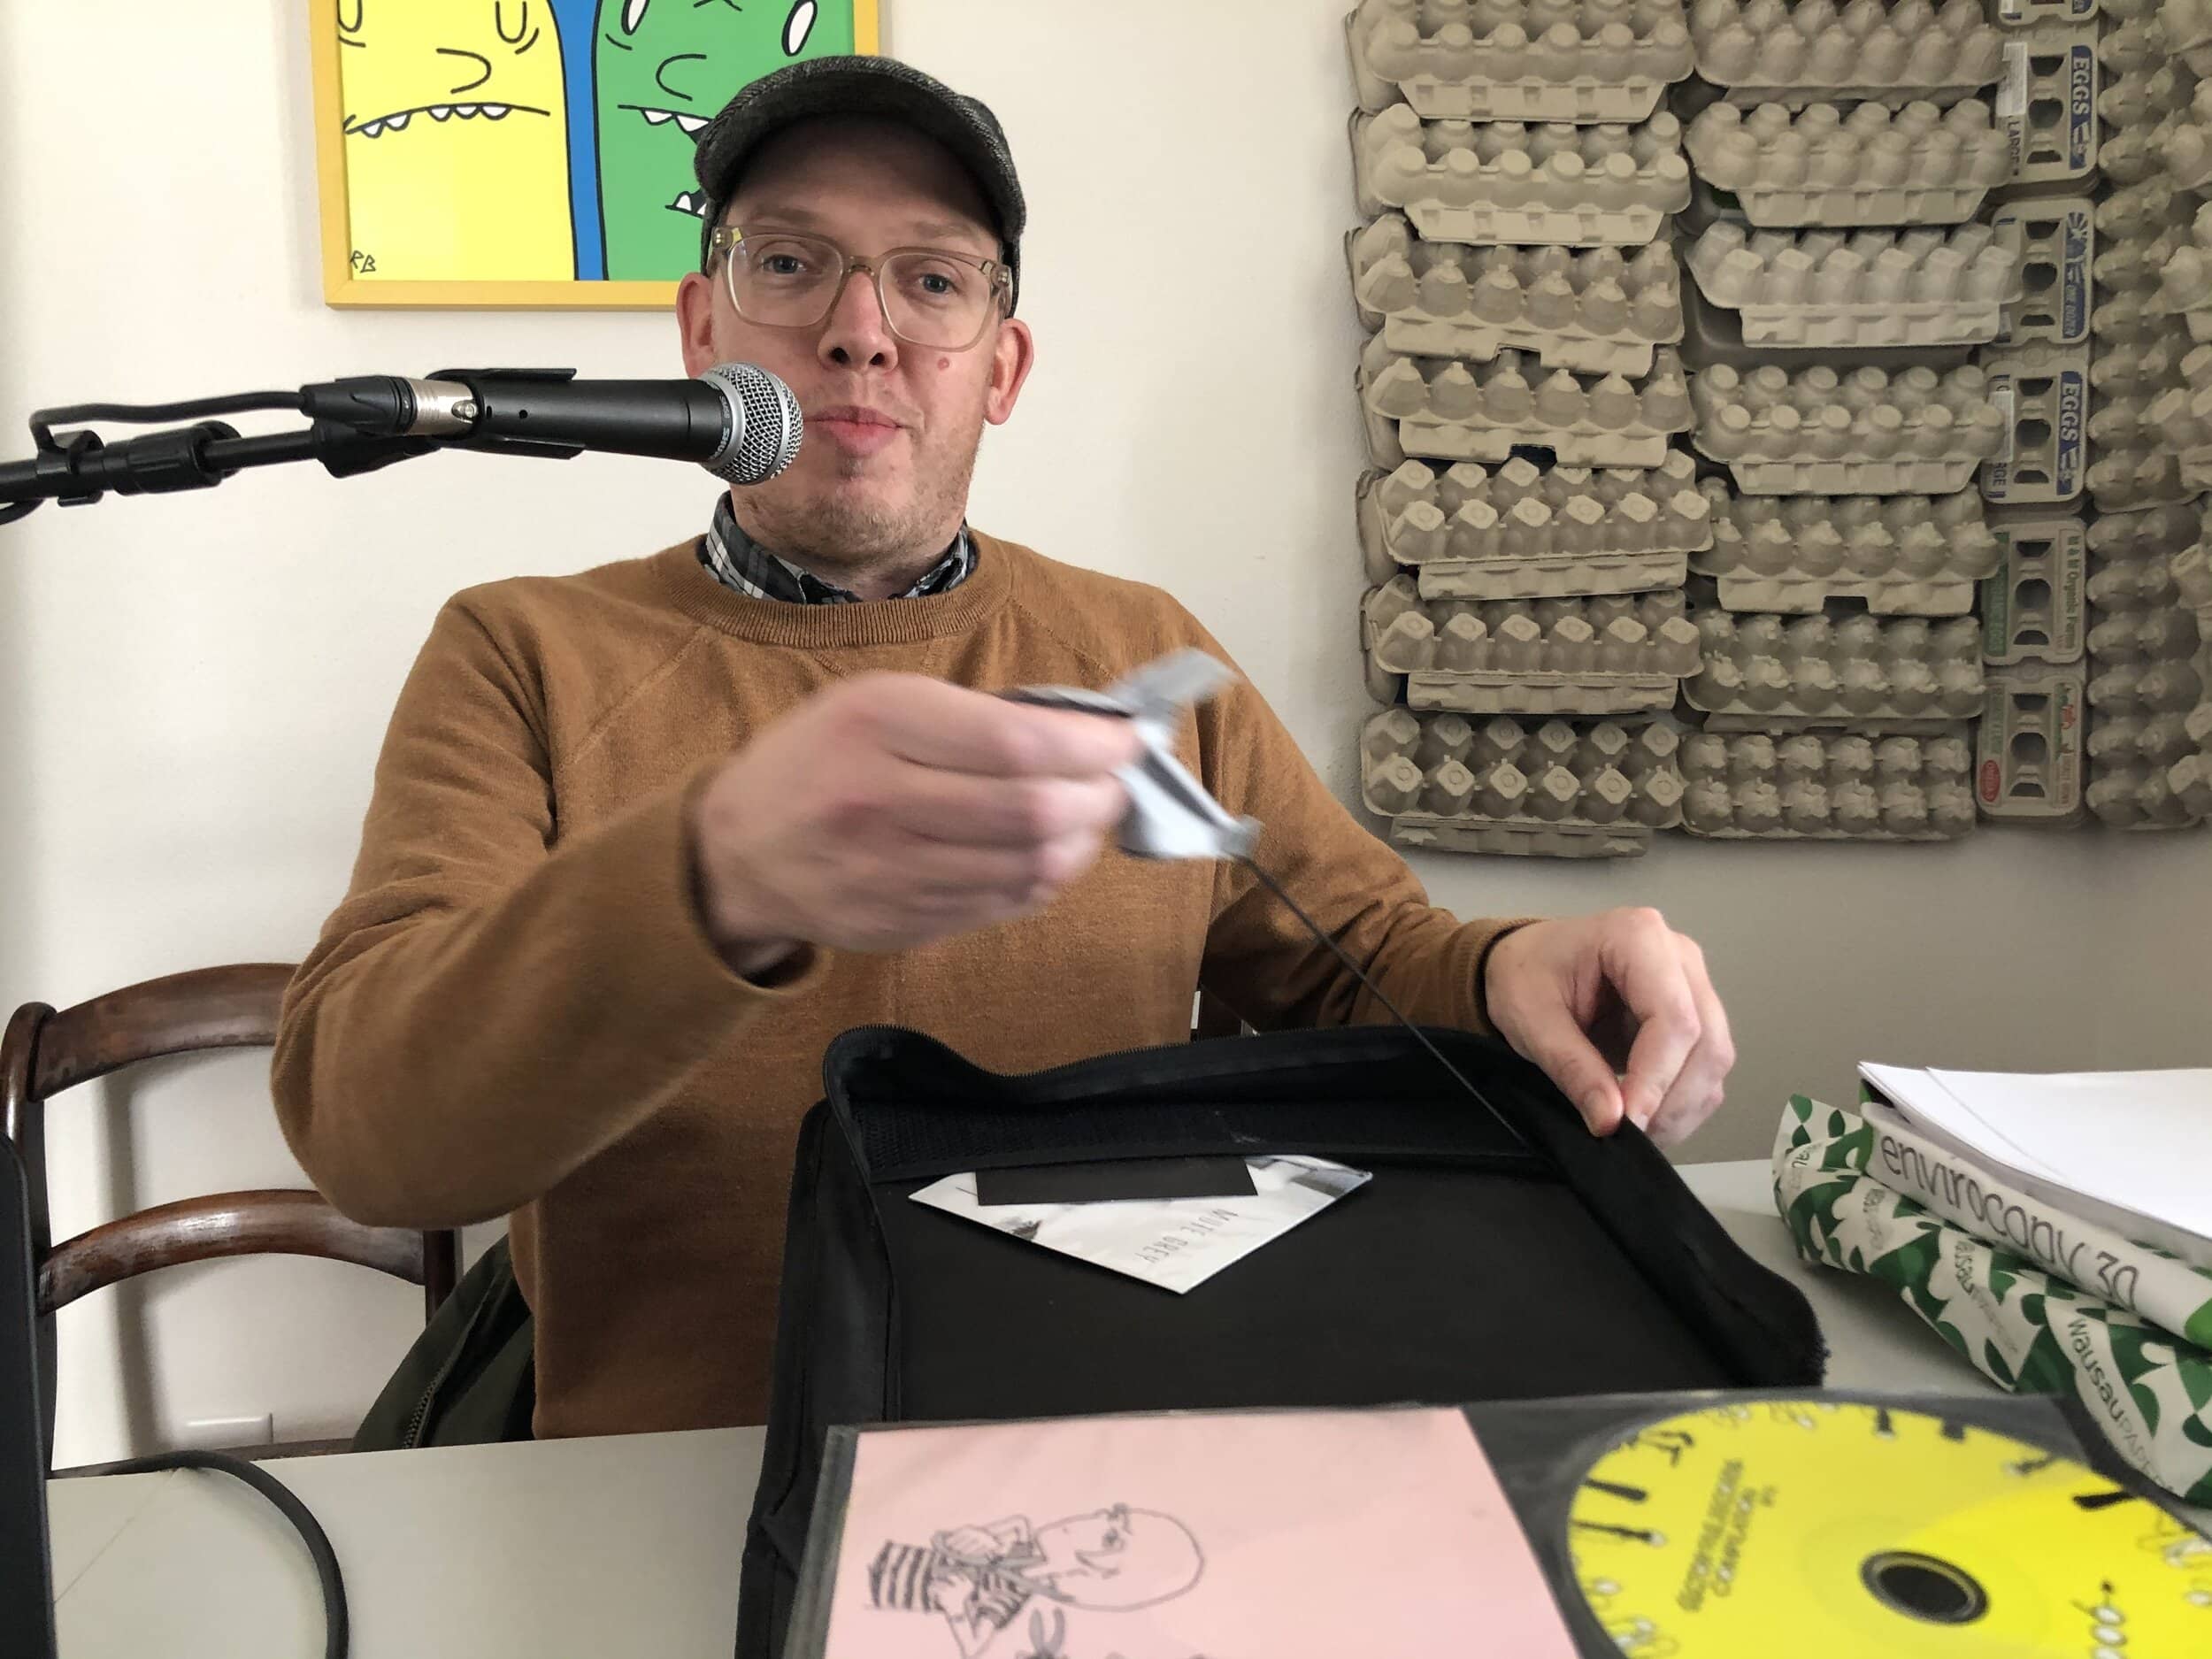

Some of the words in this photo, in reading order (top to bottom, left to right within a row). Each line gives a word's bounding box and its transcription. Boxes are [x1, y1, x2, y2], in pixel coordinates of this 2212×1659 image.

[2071, 57, 2090, 115] EGGS
[349, 250, 376, 273] RB
[2064, 304, 2076, 336] DOZEN
[2061, 382, 2081, 441] EGGS
[2063, 572, 2080, 613] Organic
[2066, 616, 2079, 649] Farms
[1134, 1236, 1188, 1263] GREY
[2096, 1250, 2139, 1313] 30
